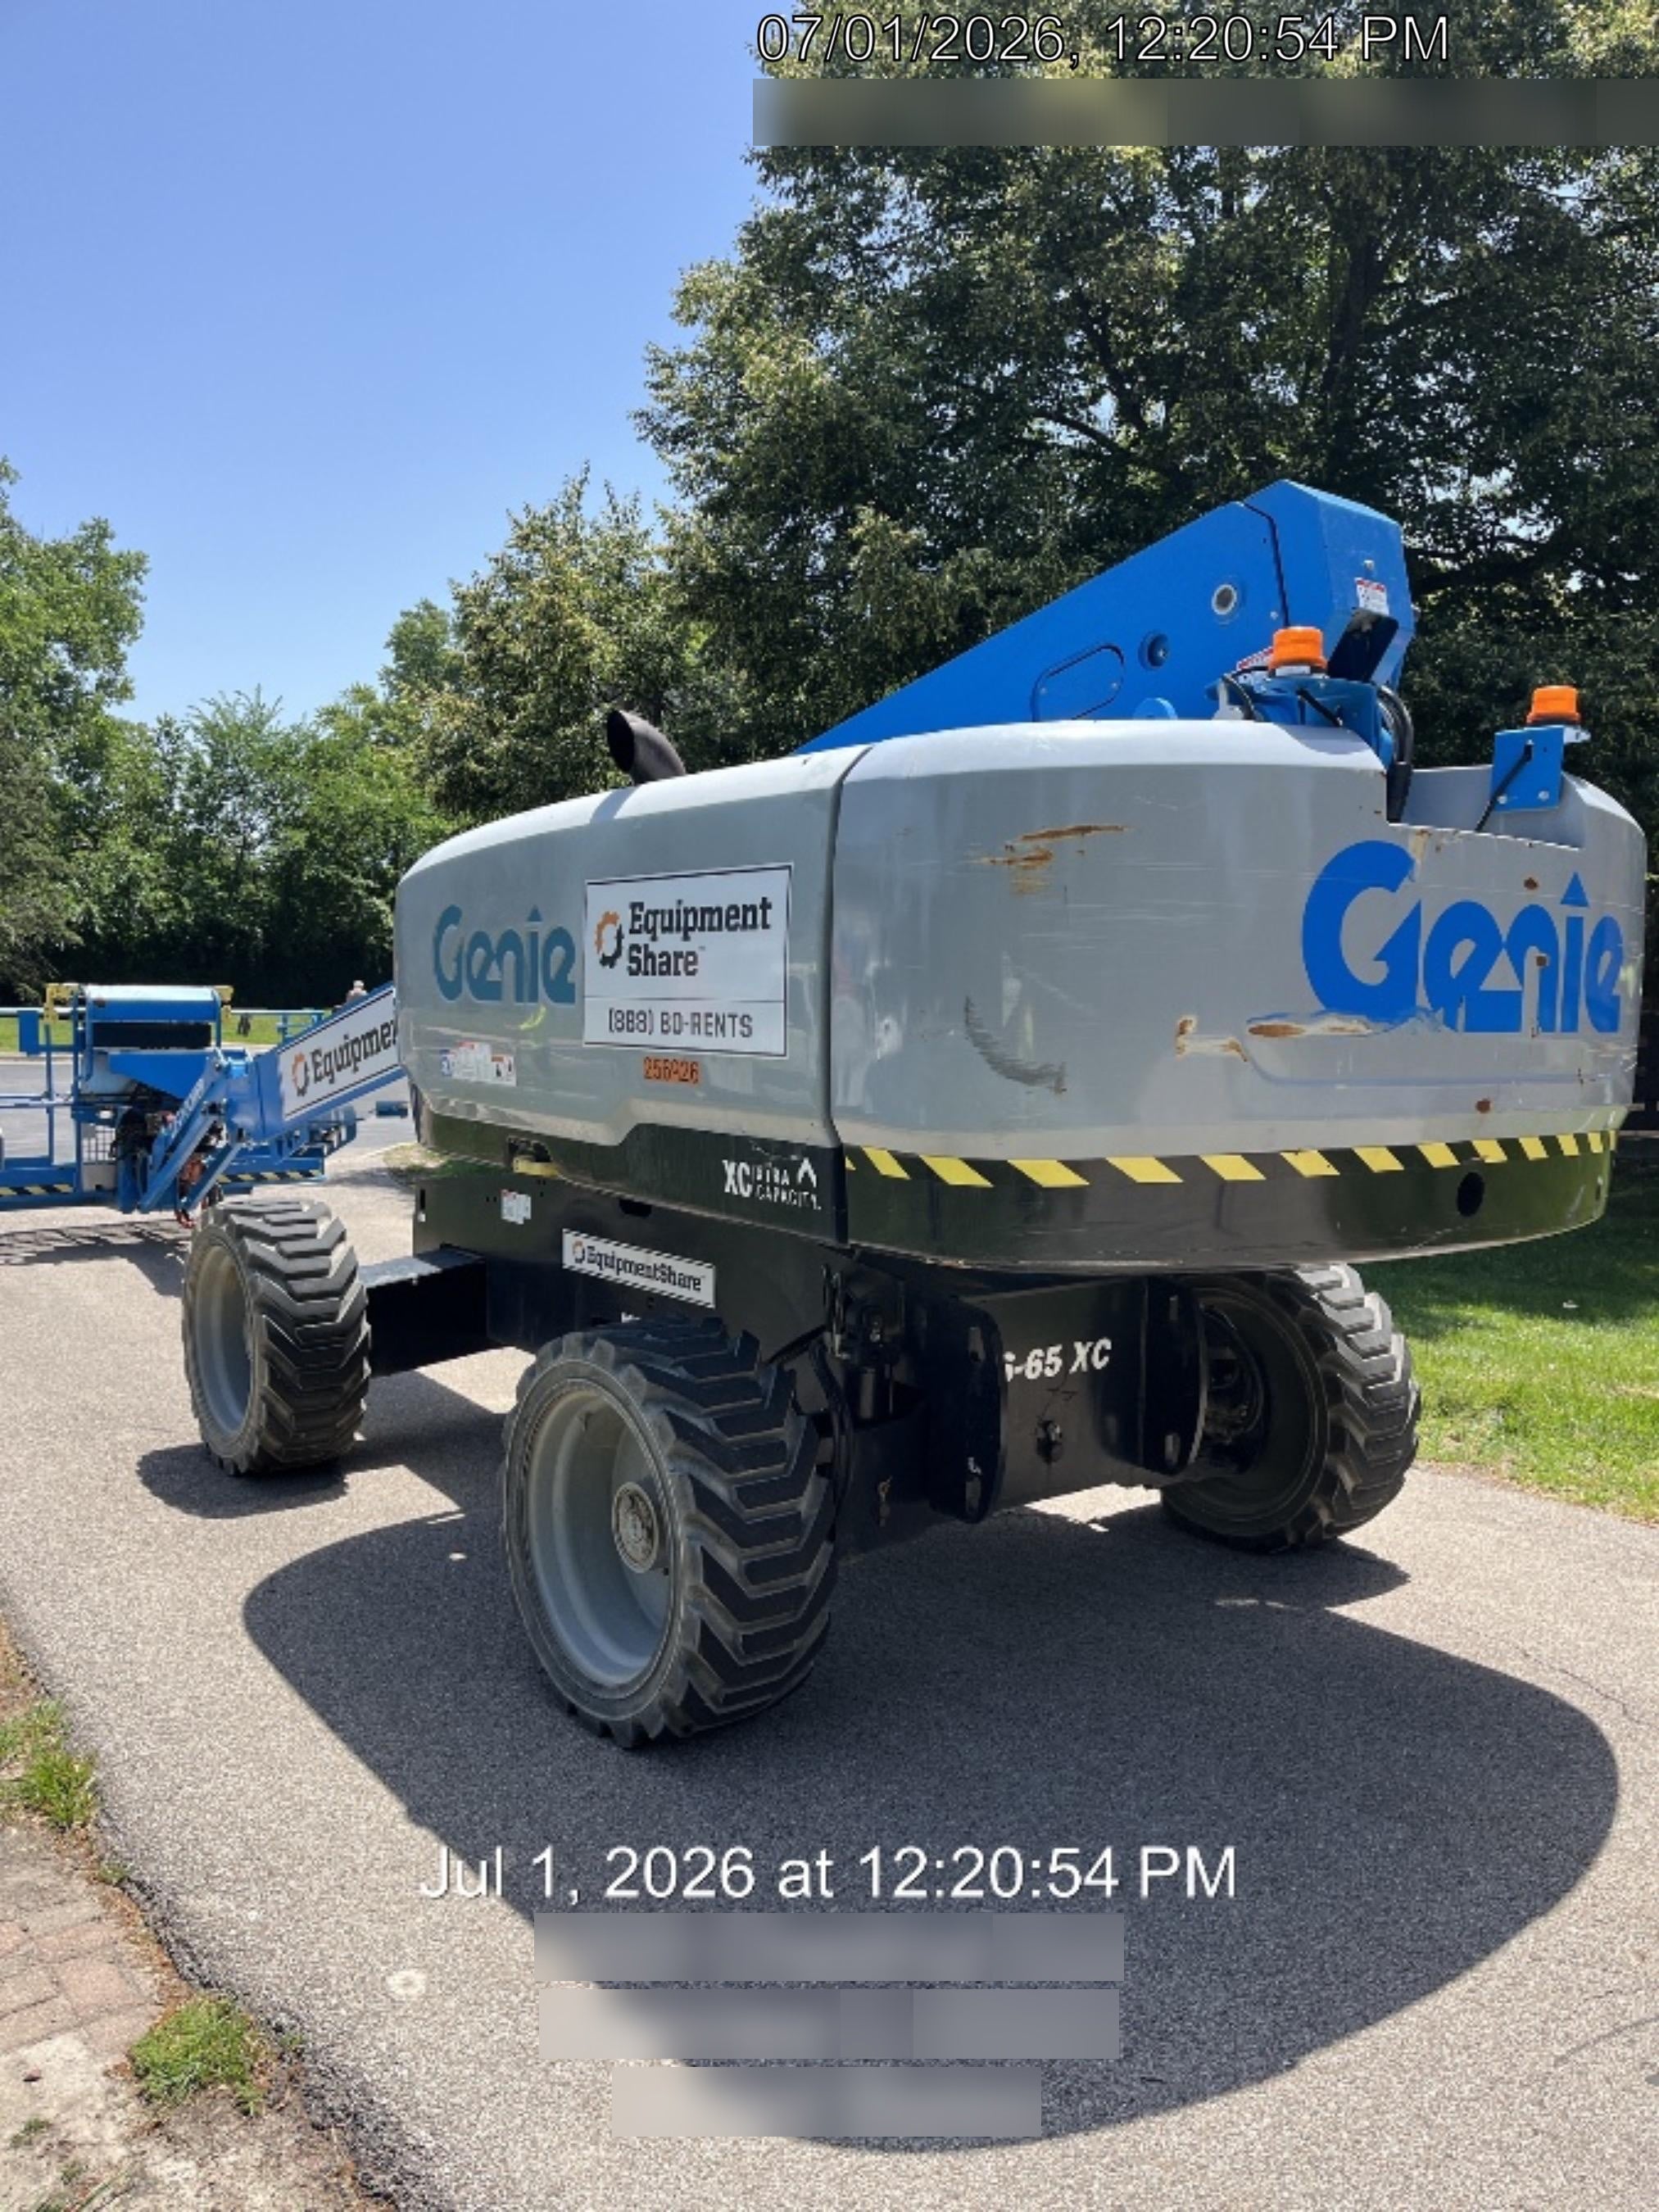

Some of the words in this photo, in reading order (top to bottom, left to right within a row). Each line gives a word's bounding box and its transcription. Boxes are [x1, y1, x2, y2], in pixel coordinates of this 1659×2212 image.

[628, 896, 773, 942] Equipment
[1302, 839, 1624, 1033] Genie
[433, 904, 576, 1004] Genie
[627, 942, 699, 977] Share
[608, 1008, 654, 1036] (888)
[722, 1159, 753, 1198] XC
[587, 1244, 702, 1292] EquipmentShare
[1068, 1336, 1113, 1375] XC
